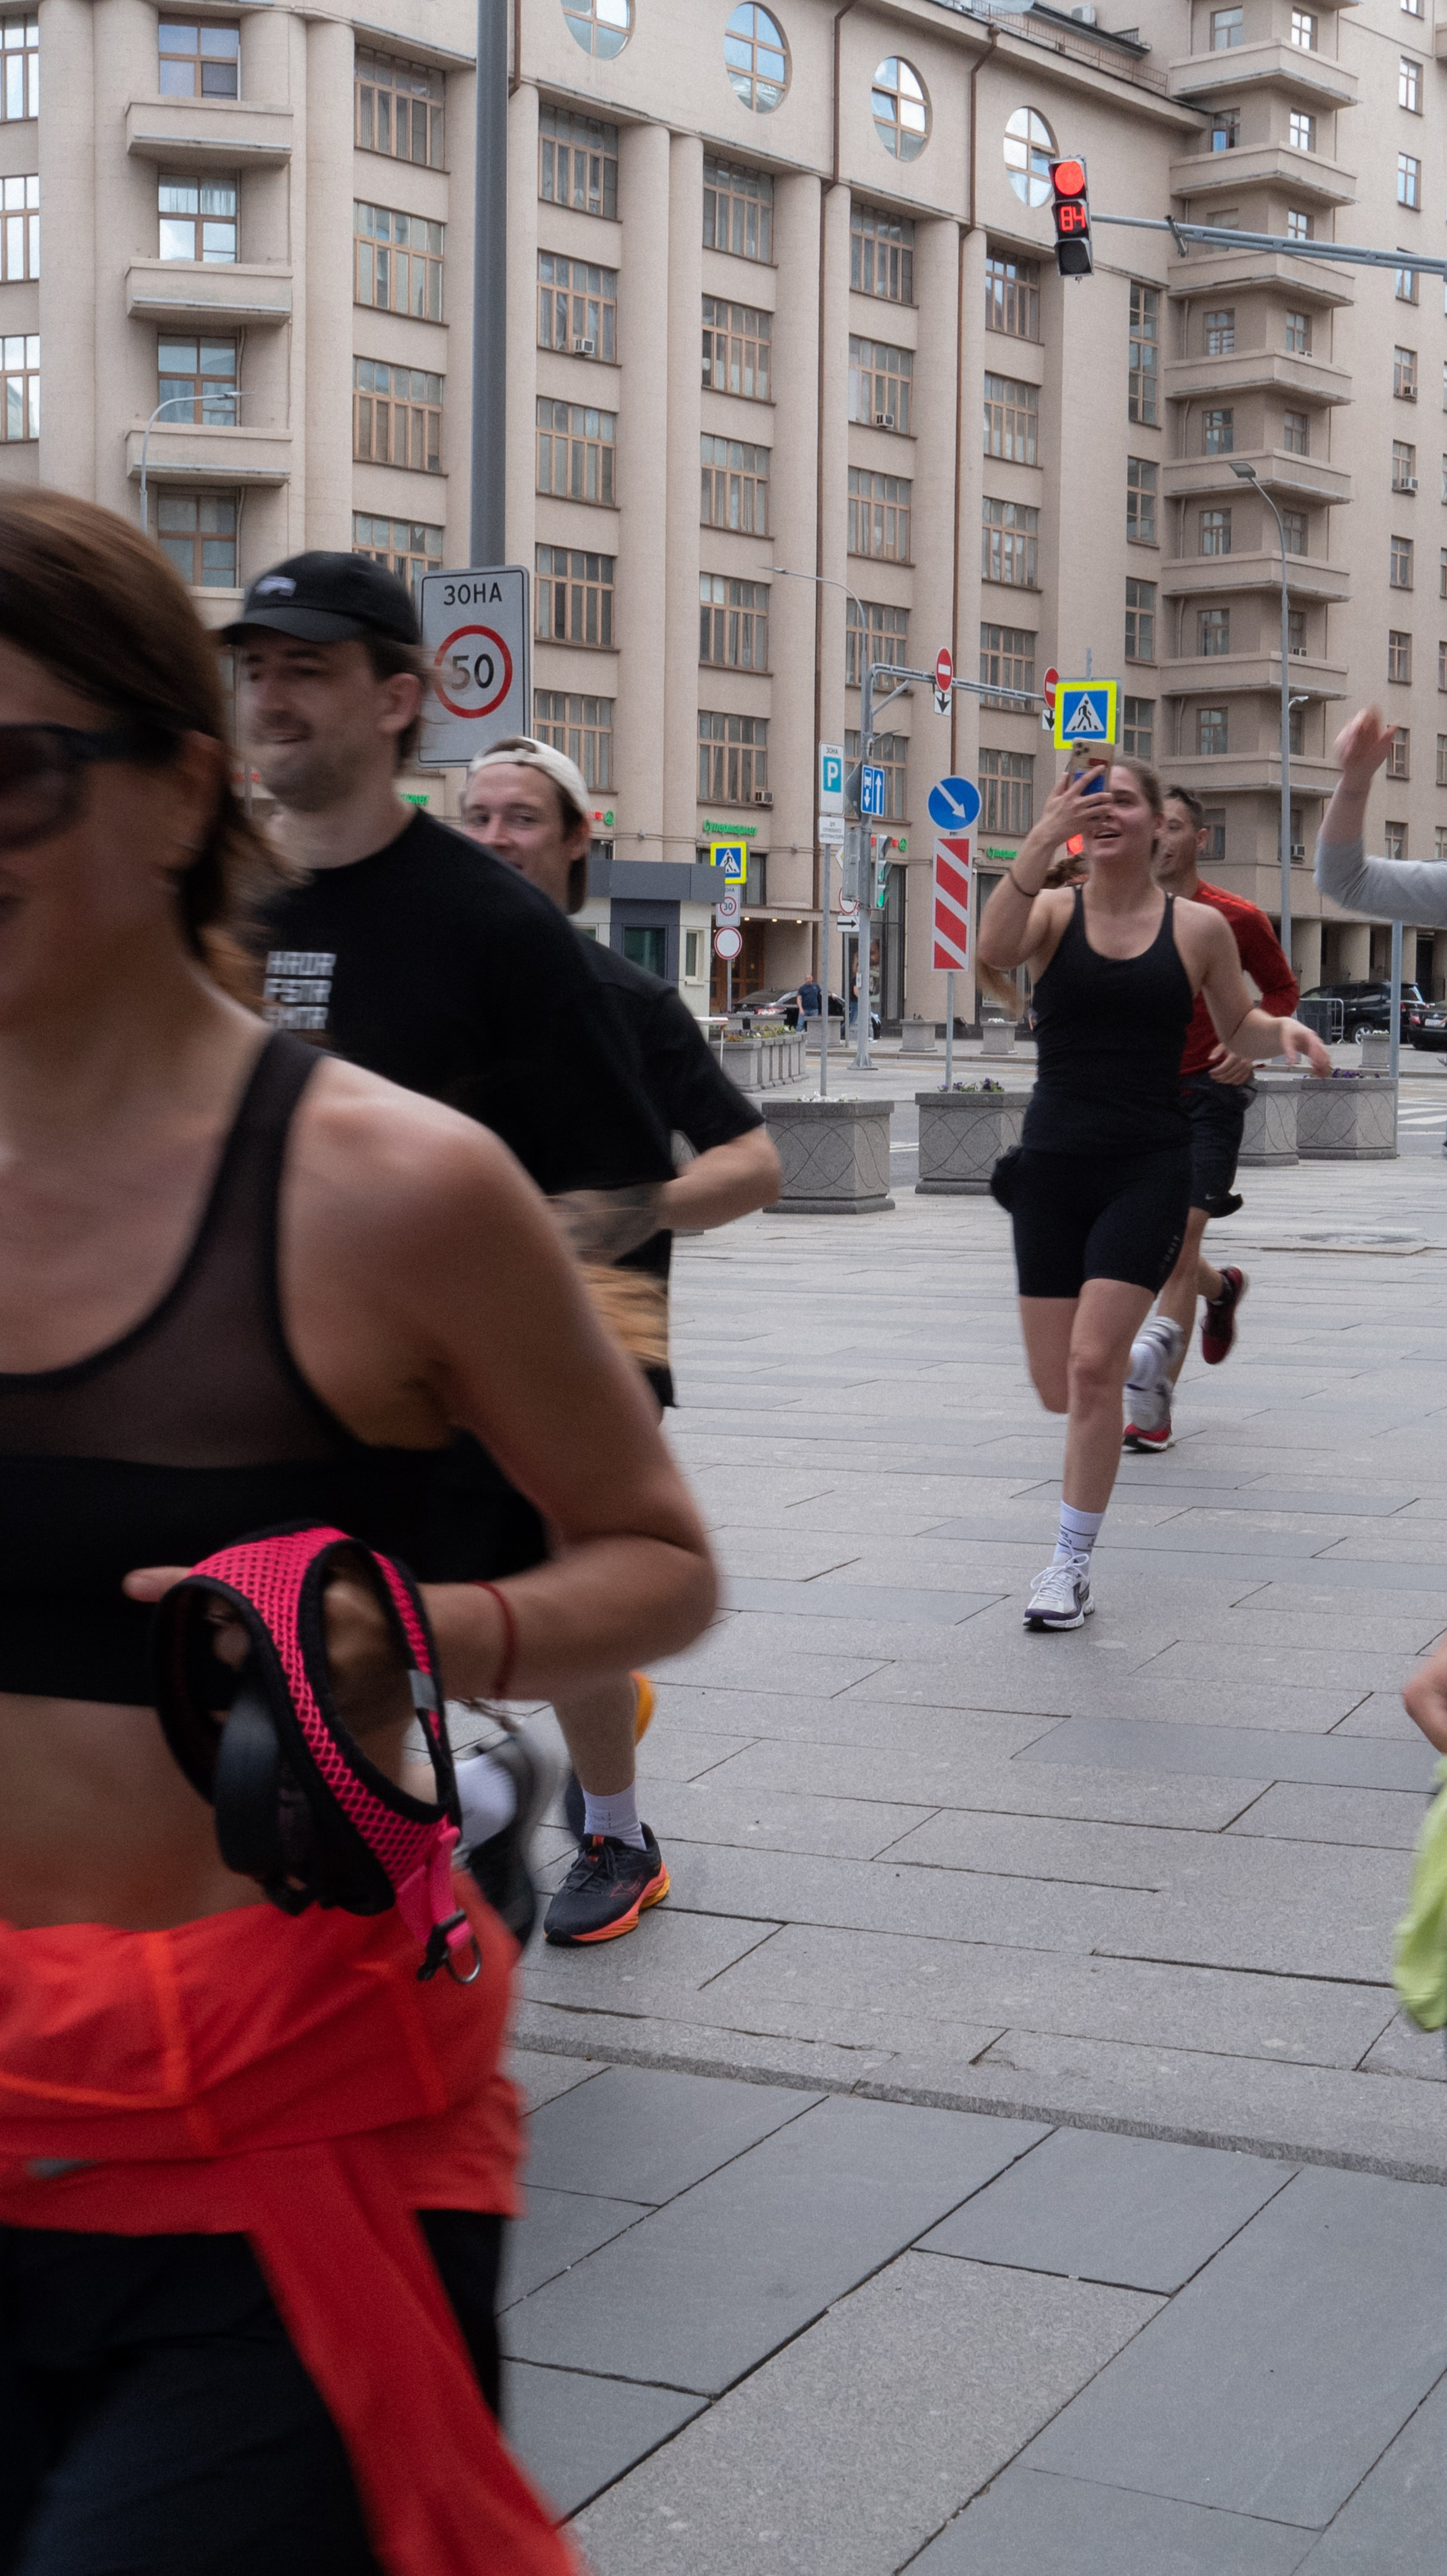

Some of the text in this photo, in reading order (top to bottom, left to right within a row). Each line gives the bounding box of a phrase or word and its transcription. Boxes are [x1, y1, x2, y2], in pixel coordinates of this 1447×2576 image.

[1060, 206, 1085, 231] 84
[443, 582, 503, 606] ЗОНА
[451, 653, 495, 690] 50
[825, 747, 838, 755] ЗОНА
[724, 902, 733, 911] 30
